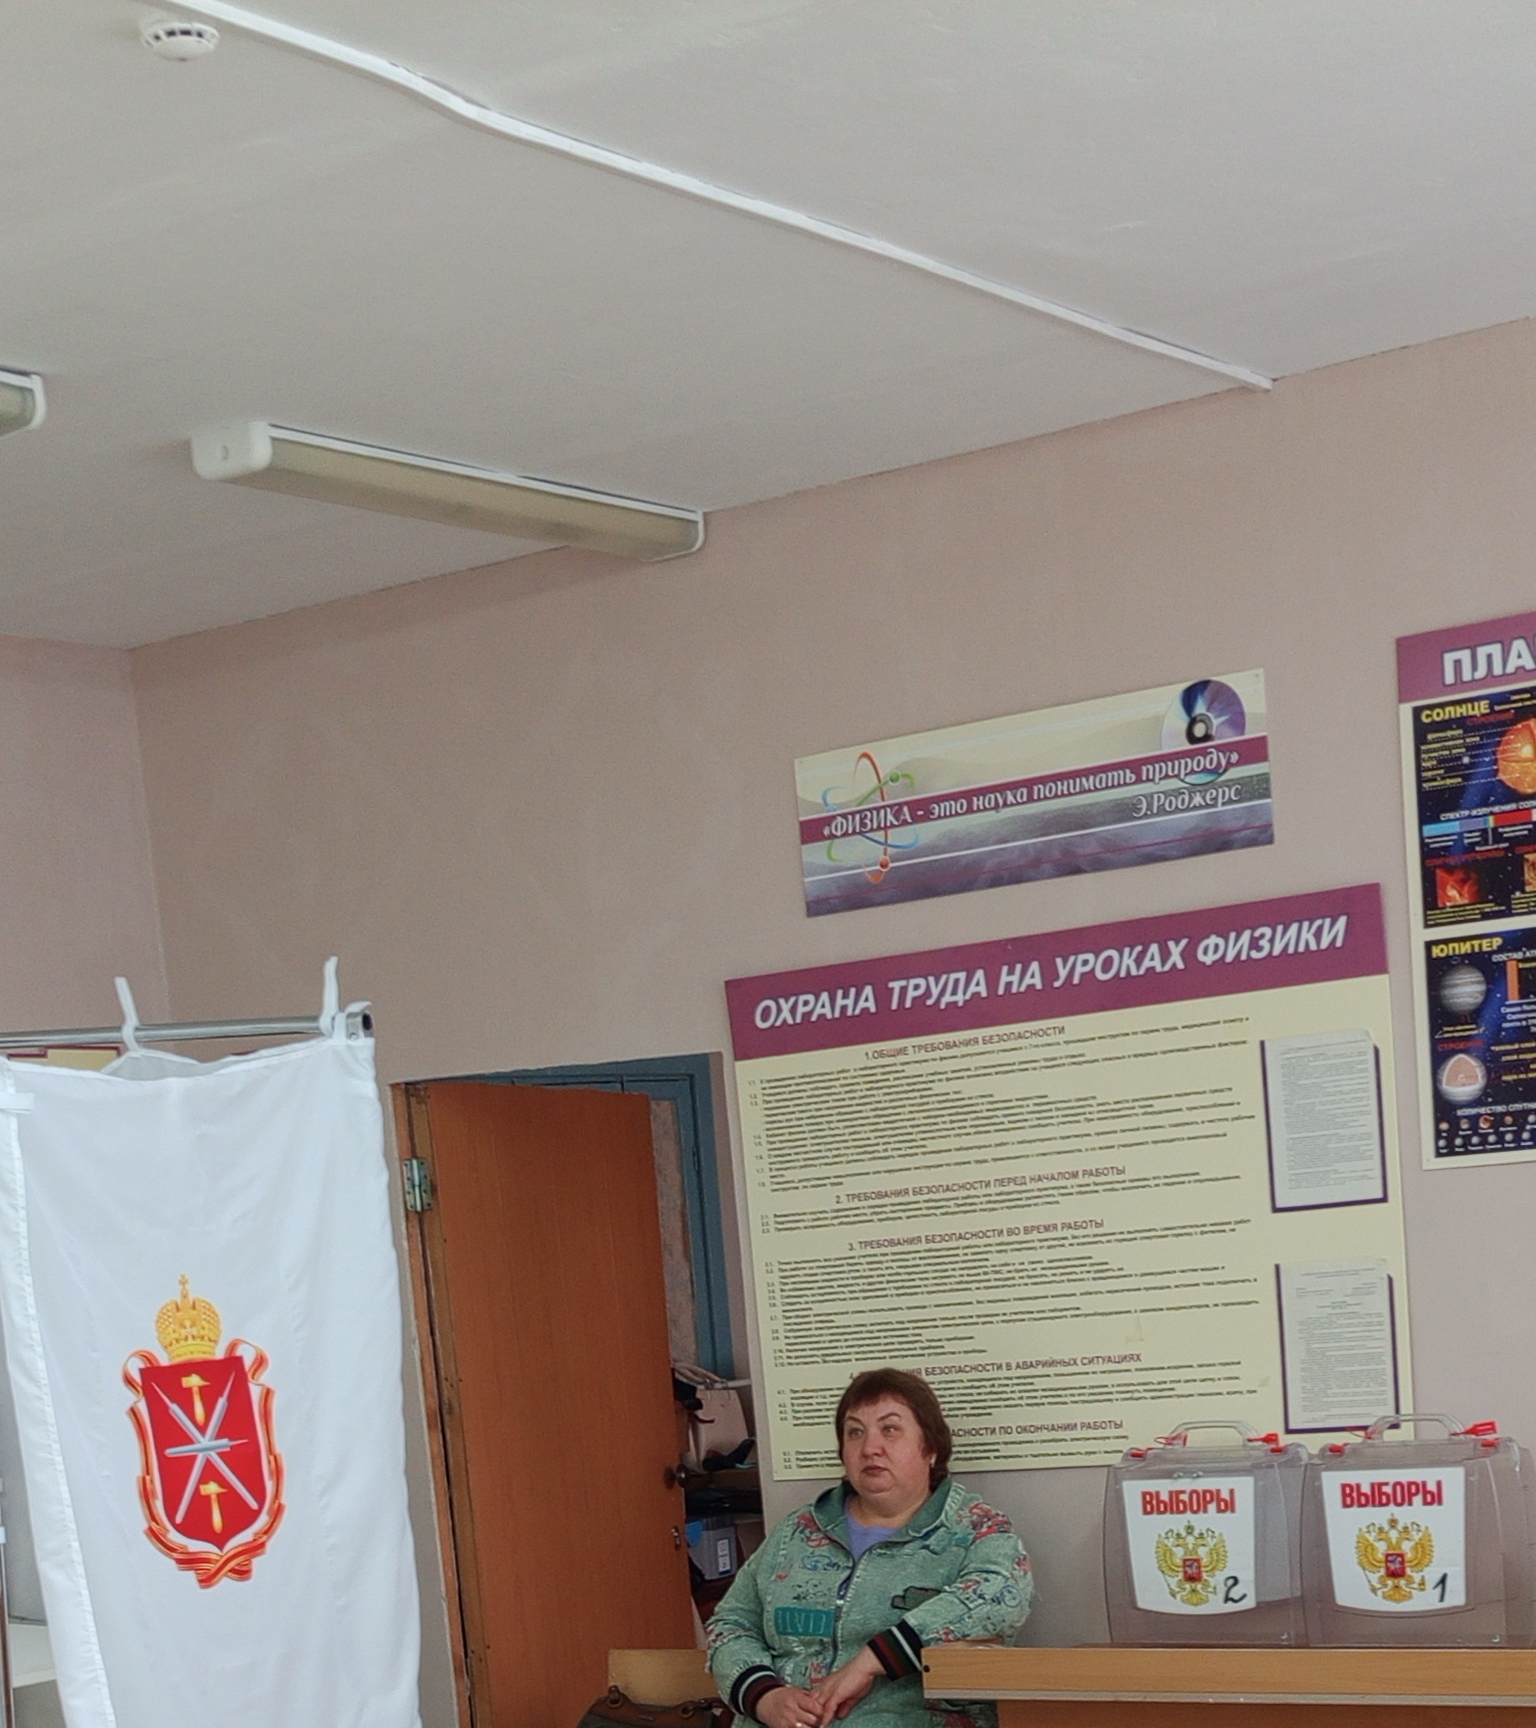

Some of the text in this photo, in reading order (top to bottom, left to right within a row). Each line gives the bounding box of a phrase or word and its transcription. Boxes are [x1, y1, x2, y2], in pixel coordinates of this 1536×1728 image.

[1421, 700, 1490, 723] СОЛНЦЕ
[823, 748, 1240, 839] «ФИЗИКА это наука понимать природу»
[1132, 782, 1242, 818] Э.Роджерс
[1431, 937, 1503, 958] ЮПИТЕР
[754, 915, 1348, 1031] ОХРАНА ТРУДА НА УРОКАХ ФИЗИКИ
[1141, 1488, 1236, 1516] ВЫБОРЫ
[1340, 1480, 1443, 1509] ВЫБОРЫ
[1223, 1575, 1247, 1604] 2
[1432, 1572, 1448, 1603] 1
